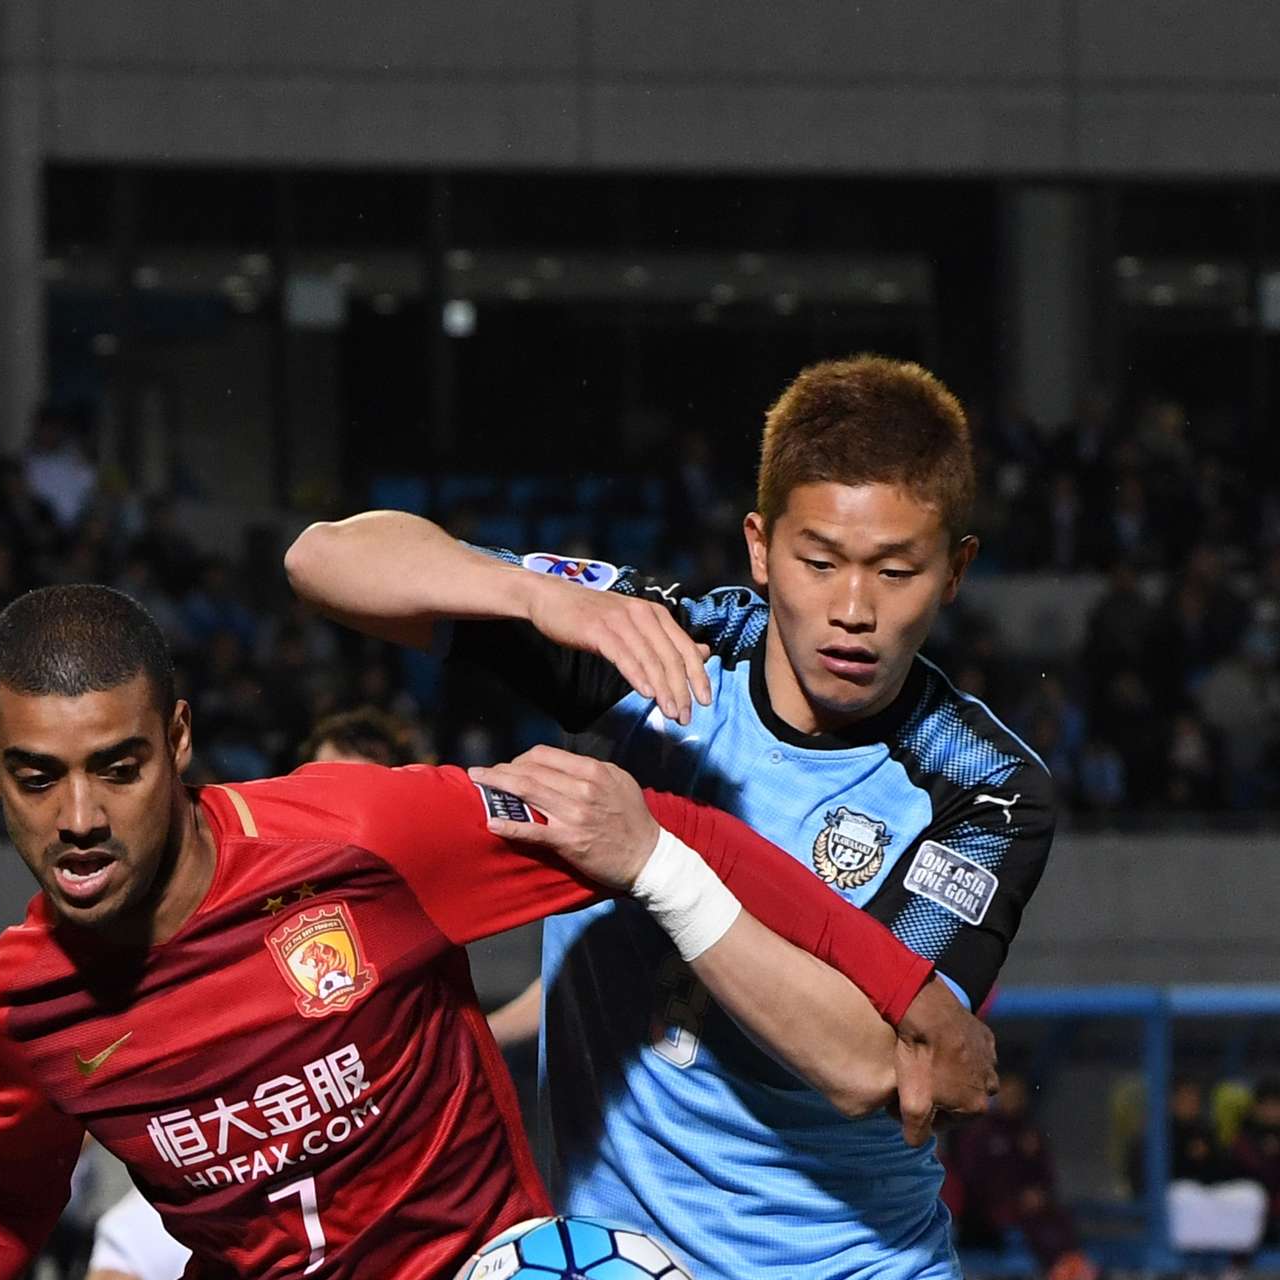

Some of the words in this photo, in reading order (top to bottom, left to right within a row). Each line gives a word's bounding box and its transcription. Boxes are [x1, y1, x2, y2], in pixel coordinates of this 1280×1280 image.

[913, 867, 946, 892] ONE
[944, 882, 981, 914] GOAL
[922, 851, 954, 877] ONE
[951, 867, 987, 898] ASIA
[147, 1042, 370, 1168] 恒大金服
[184, 1097, 381, 1189] HDFAX.COM
[268, 1176, 326, 1275] 7
